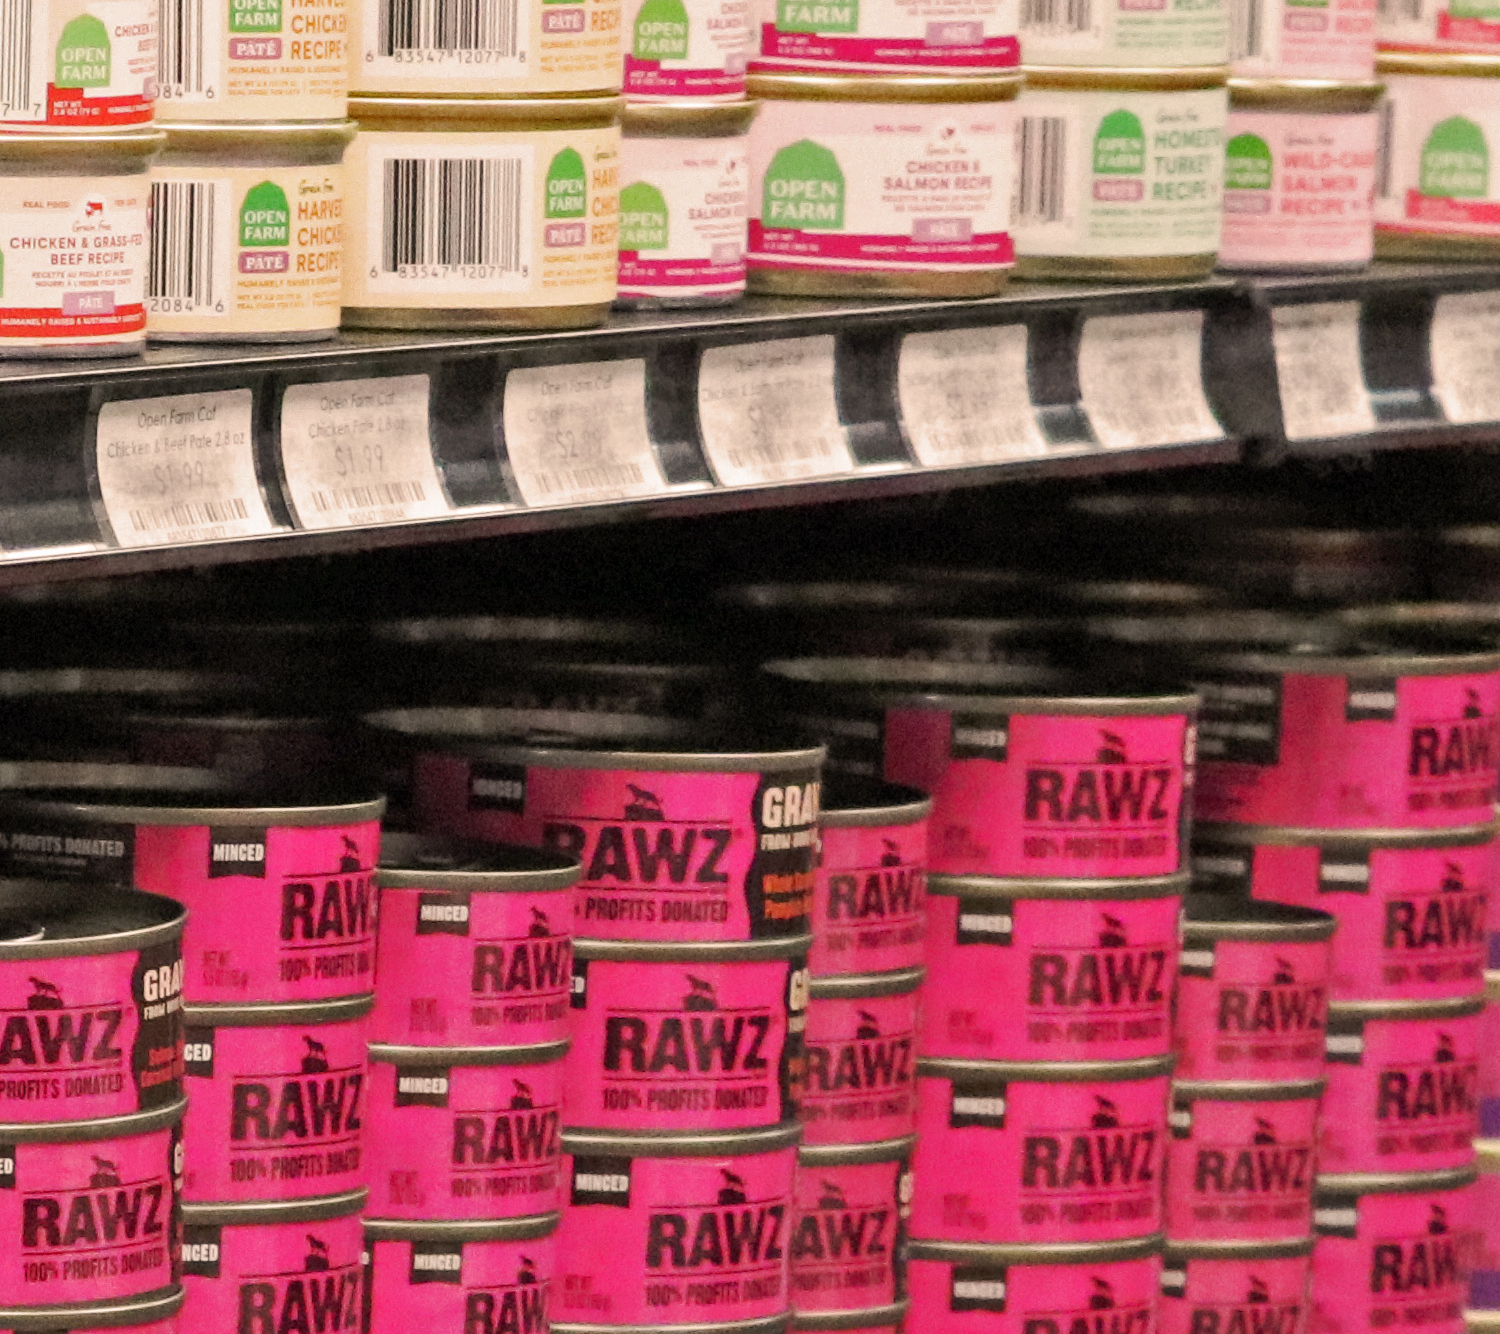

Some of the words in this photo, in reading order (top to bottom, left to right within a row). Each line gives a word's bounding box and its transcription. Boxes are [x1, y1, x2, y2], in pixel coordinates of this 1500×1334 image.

[10, 237, 76, 249] CHICKEN
[82, 237, 88, 248] &
[51, 253, 83, 265] BEEF
[88, 252, 124, 264] RECIPE
[1024, 768, 1170, 820] RAWZ
